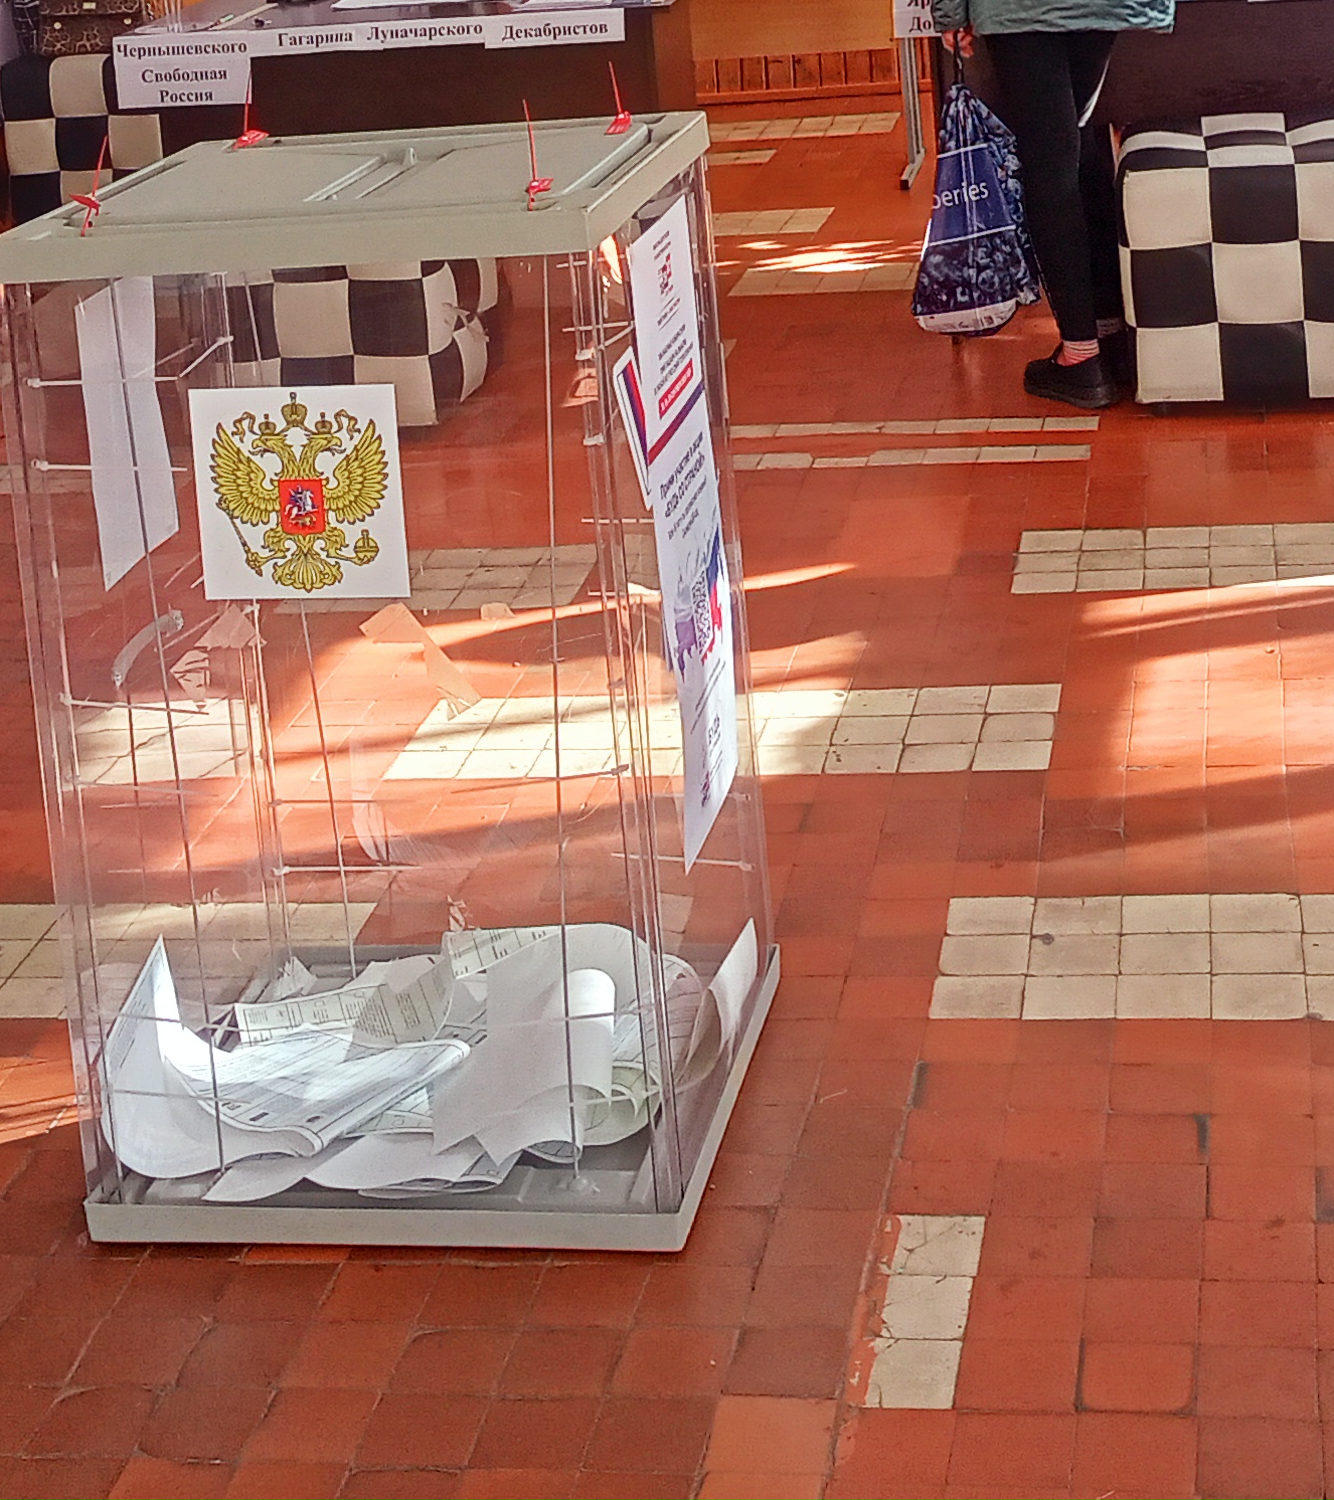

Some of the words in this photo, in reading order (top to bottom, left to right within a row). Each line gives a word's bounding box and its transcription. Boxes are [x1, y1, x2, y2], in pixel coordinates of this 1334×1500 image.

[277, 29, 353, 48] Гагарина
[366, 22, 483, 44] Луначарского
[501, 20, 609, 42] Декабристов
[116, 42, 247, 60] Чернышевского
[141, 67, 227, 83] Свободная
[159, 89, 214, 103] Россия
